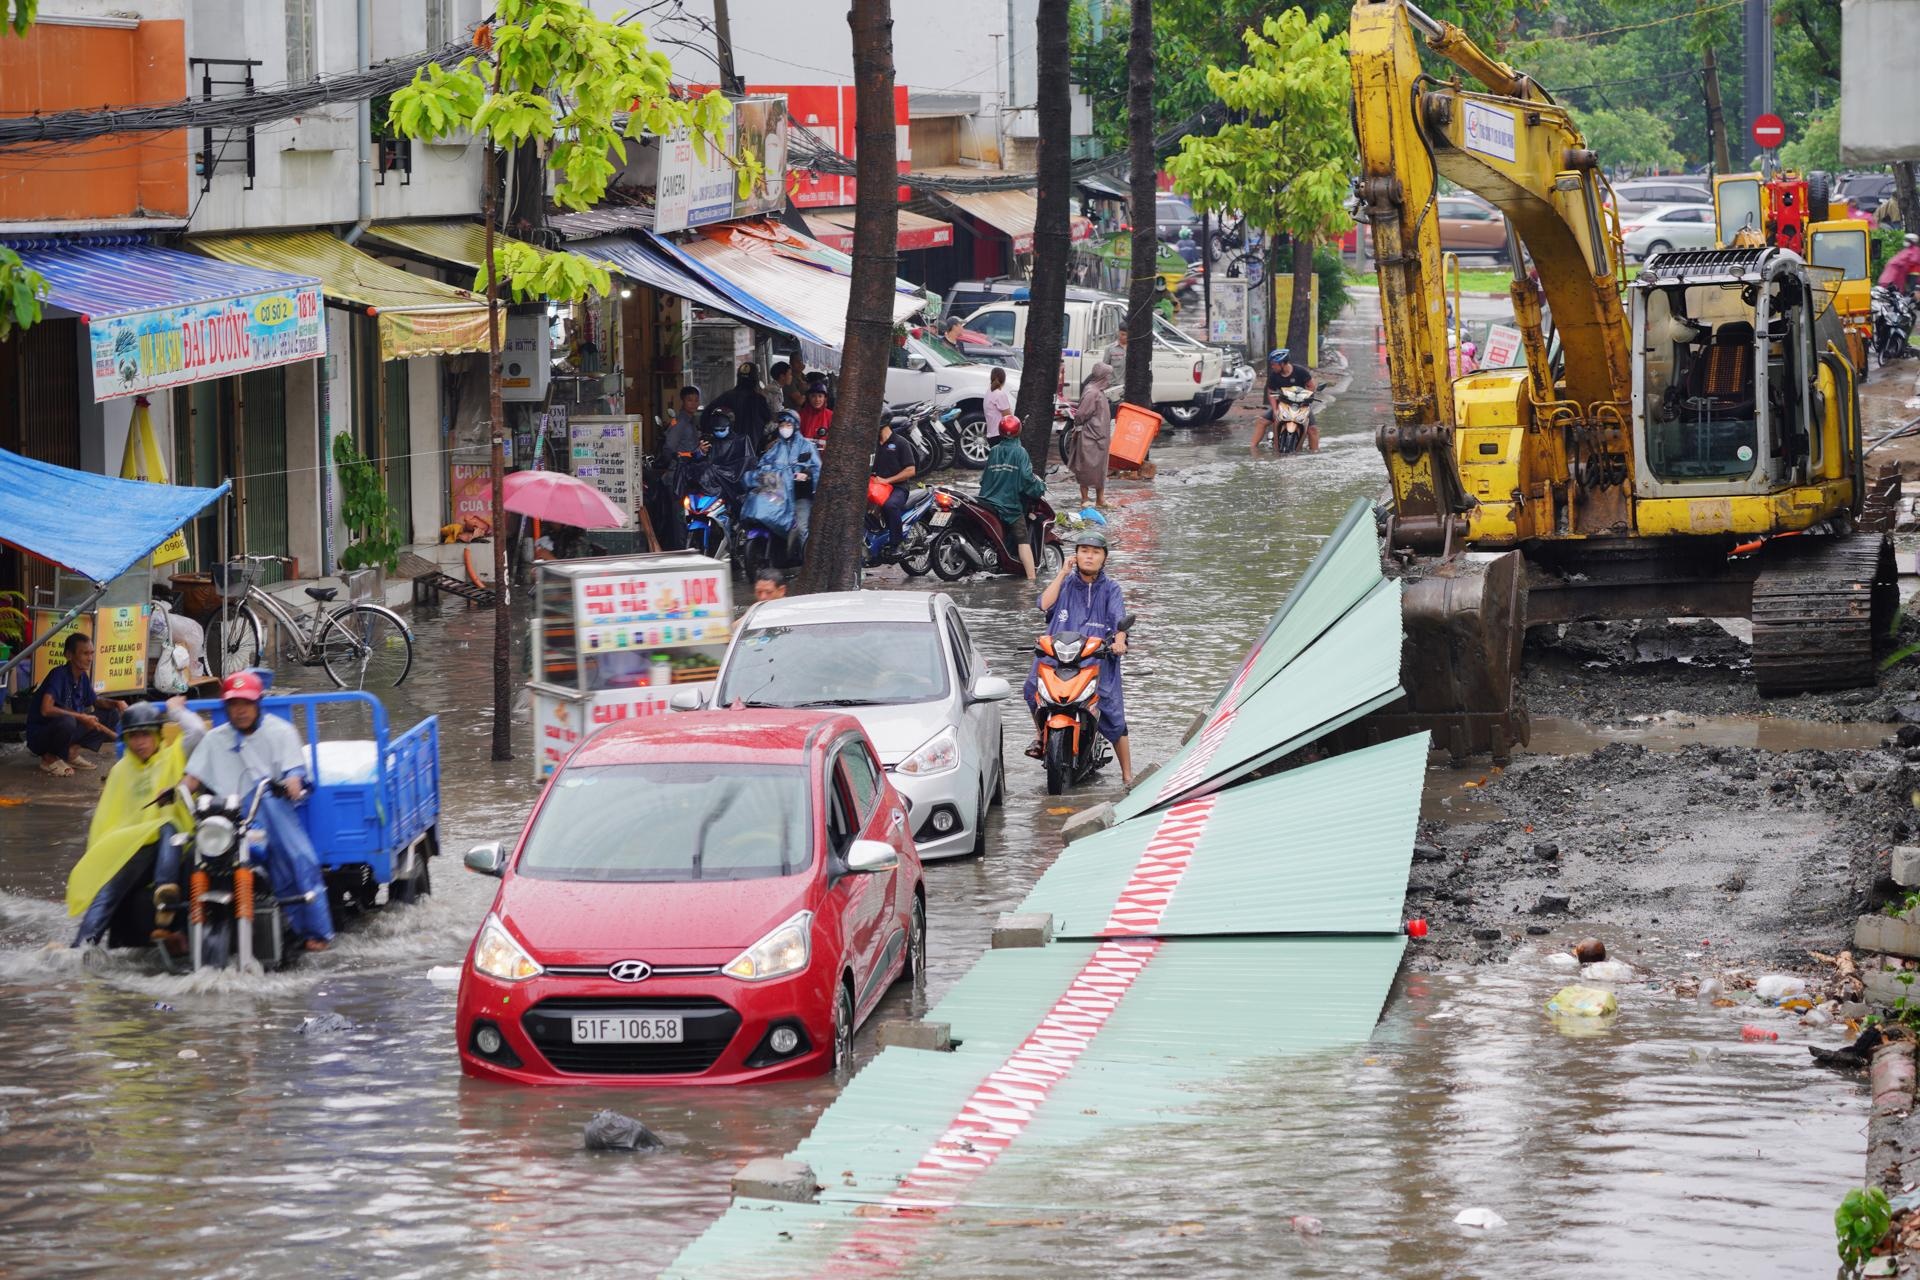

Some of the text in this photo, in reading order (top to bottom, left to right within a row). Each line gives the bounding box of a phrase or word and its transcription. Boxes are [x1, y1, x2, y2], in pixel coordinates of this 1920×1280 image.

[662, 174, 685, 198] CAMERA
[297, 290, 316, 318] 181A
[455, 464, 491, 479] CANH
[460, 500, 484, 512] CUA
[682, 577, 719, 606] 10K
[100, 645, 116, 654] CAFE
[118, 643, 135, 653] MANG
[109, 656, 124, 665] CAM
[109, 669, 122, 678] RAU
[577, 1020, 677, 1040] 51F-106.58
